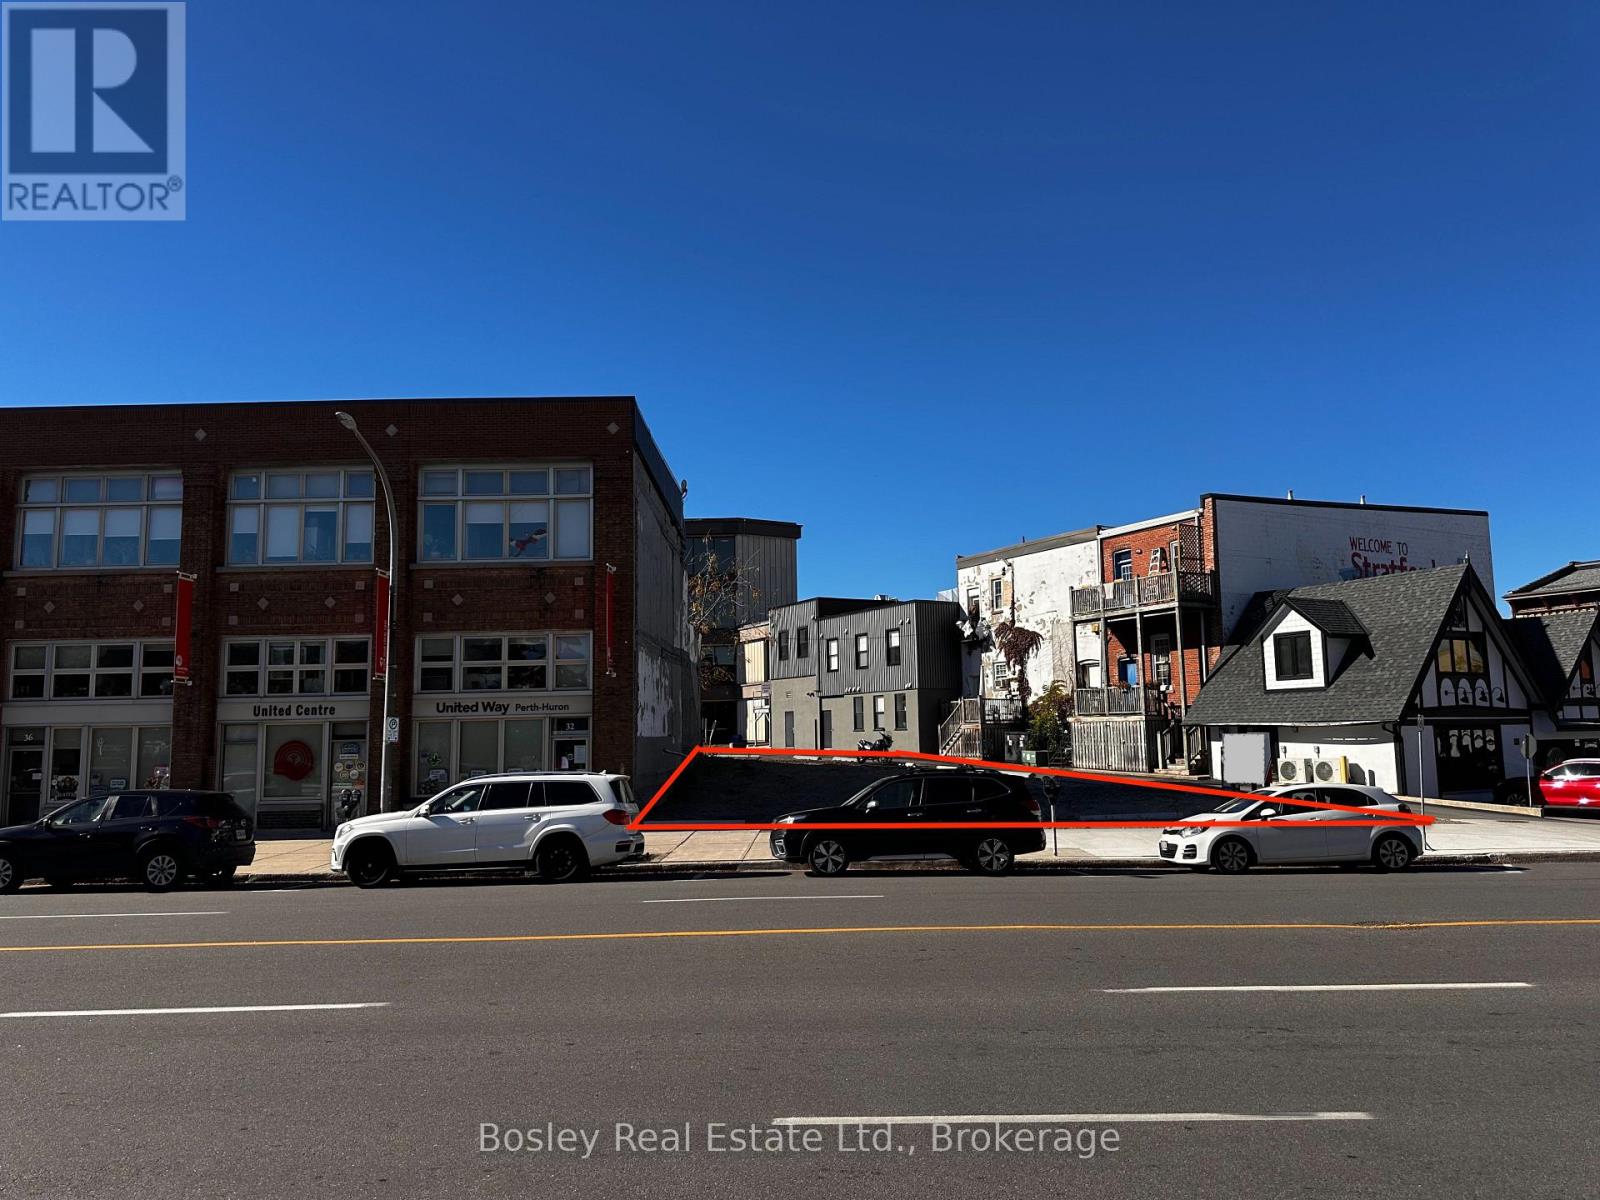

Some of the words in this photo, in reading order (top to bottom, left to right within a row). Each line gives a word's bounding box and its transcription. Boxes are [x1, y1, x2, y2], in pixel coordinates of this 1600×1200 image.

[1349, 536, 1393, 554] WELCOME
[1396, 542, 1408, 556] TO
[1351, 552, 1436, 578] Stratf
[253, 704, 292, 717] United
[296, 704, 336, 716] Centre
[436, 702, 479, 713] United
[481, 702, 510, 715] Way
[515, 703, 570, 712] Perth-Huron
